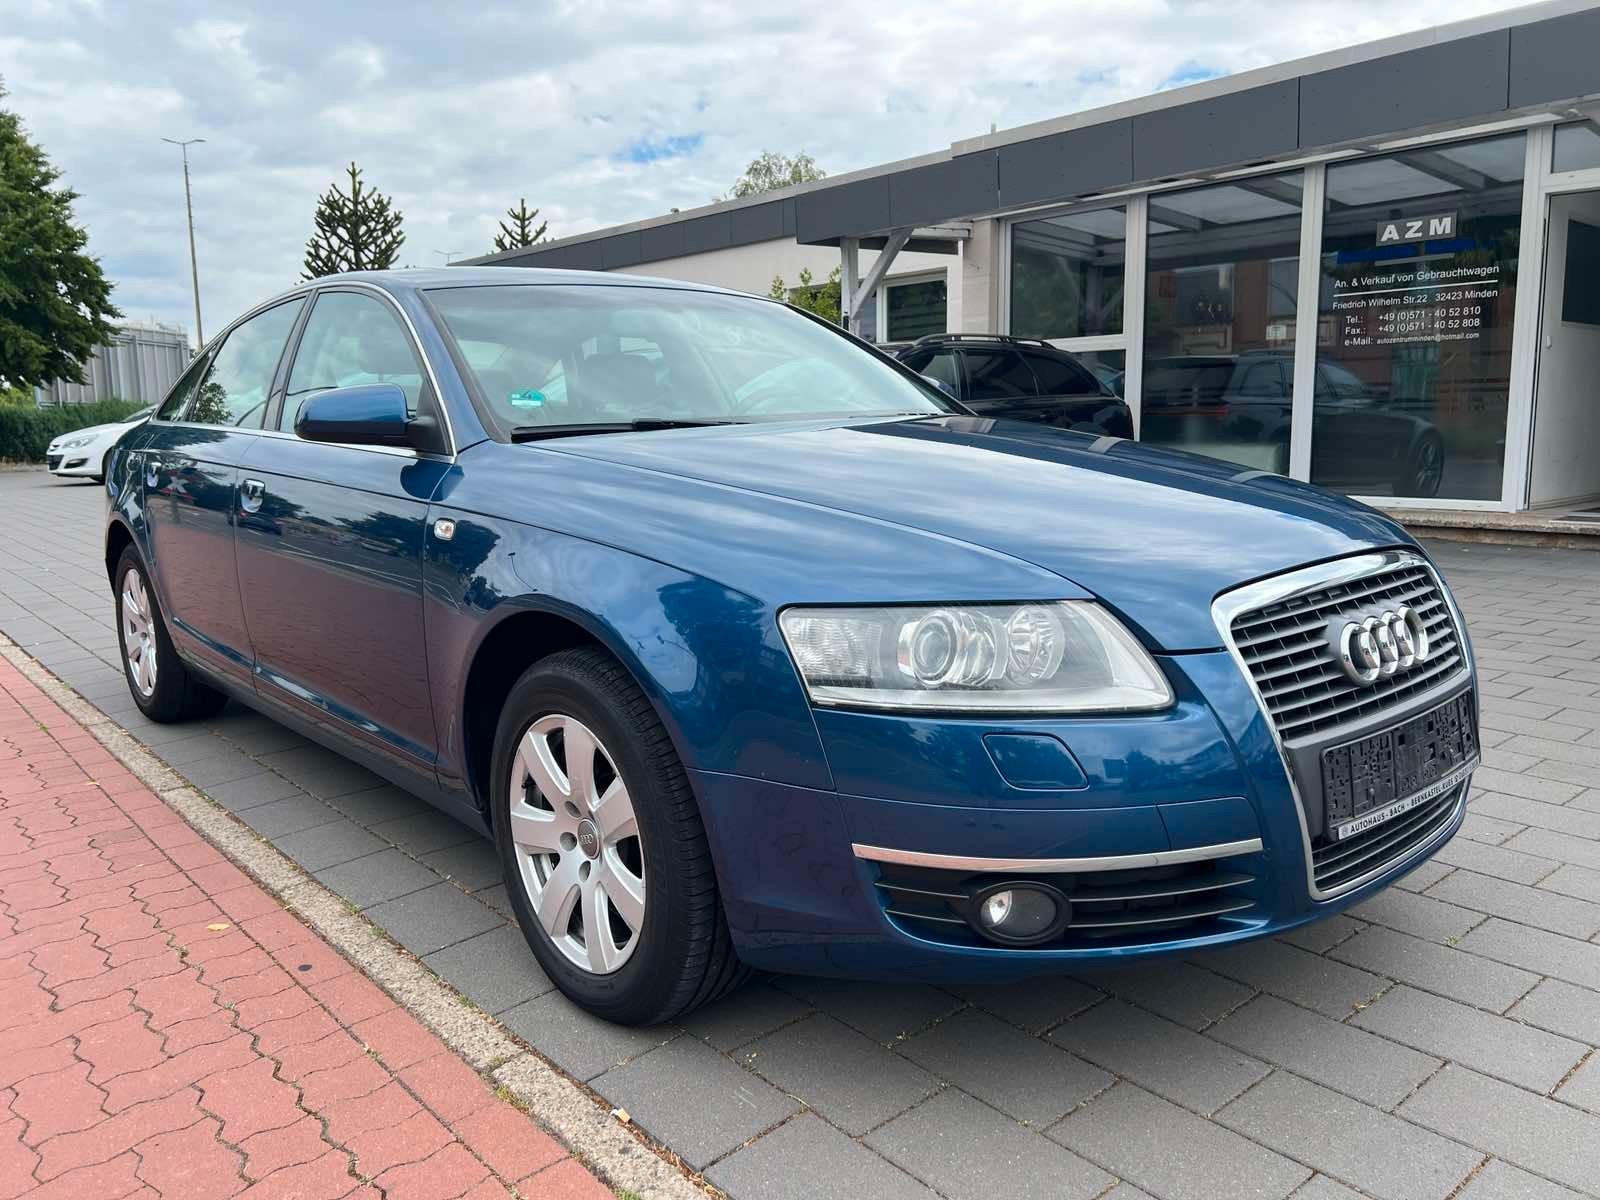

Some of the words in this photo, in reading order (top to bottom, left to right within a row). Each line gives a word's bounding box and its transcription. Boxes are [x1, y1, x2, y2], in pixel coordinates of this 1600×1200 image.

[1334, 280, 1349, 288] An.
[1352, 278, 1358, 287] &
[1360, 274, 1395, 285] Verkauf
[1397, 274, 1414, 282] von
[1416, 266, 1500, 280] Gebrauchtwagen
[1333, 300, 1367, 309] Friedrich
[1368, 298, 1401, 307] Wilhelm
[1403, 295, 1428, 303] Str.22
[1435, 291, 1463, 301] 32423
[1464, 290, 1498, 298] Minden
[1379, 312, 1395, 320] +49
[1397, 310, 1425, 322] (0)571
[1434, 308, 1446, 317] 40
[1448, 307, 1461, 316] 52
[1463, 306, 1481, 315] 810
[1379, 324, 1395, 332] +49
[1397, 322, 1425, 333] (0)571
[1434, 320, 1446, 328] 40
[1448, 319, 1460, 328] 52
[1462, 318, 1480, 327] 808
[1344, 337, 1373, 346] e-Mail:
[1350, 814, 1385, 833] AUTOHAUS
[1390, 804, 1405, 817] BACH
